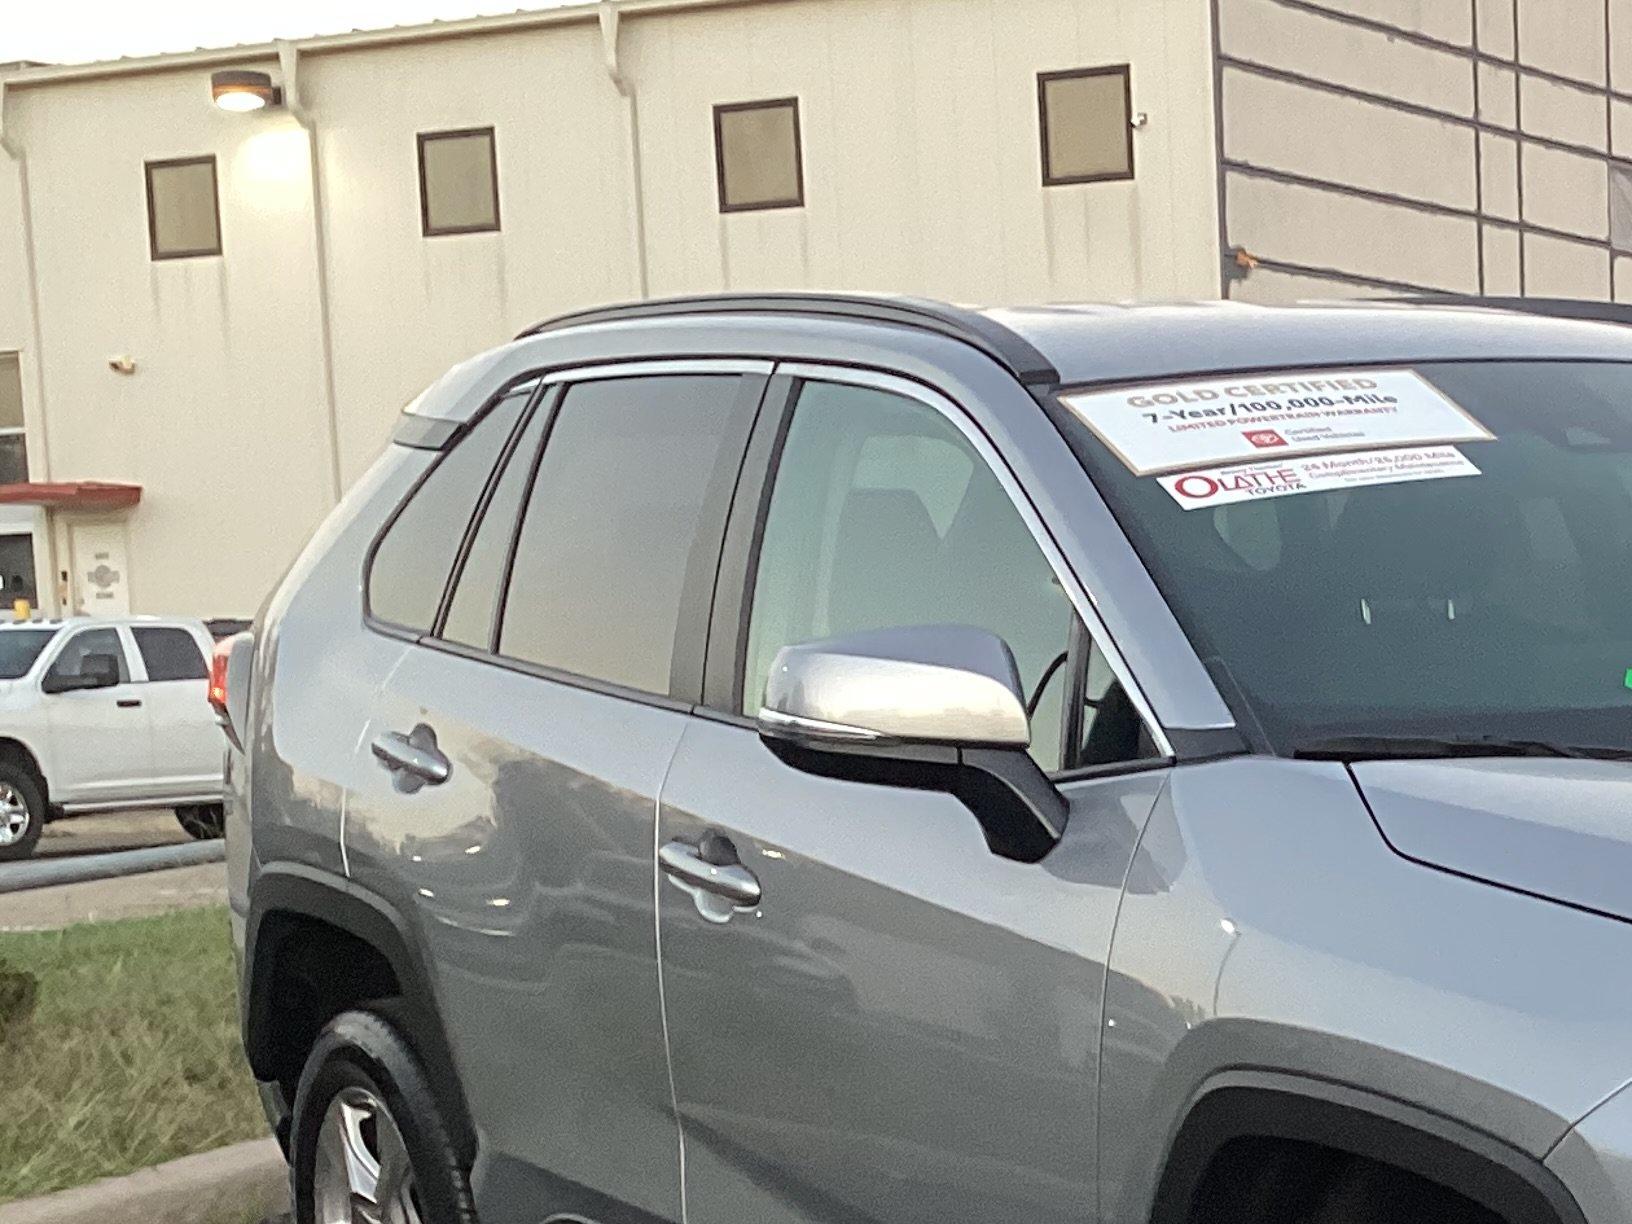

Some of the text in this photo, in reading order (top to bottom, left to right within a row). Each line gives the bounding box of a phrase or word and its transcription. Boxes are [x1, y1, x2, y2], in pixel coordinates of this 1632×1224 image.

[1127, 378, 1377, 408] GOLD CERTIFIED
[1142, 393, 1398, 424] 7-Year/100,000-Mile
[1168, 405, 1398, 433] LIMITED POWERTRAIN WARRANTY
[1174, 468, 1302, 498] OLATHE
[1245, 482, 1307, 496] TOYOTA
